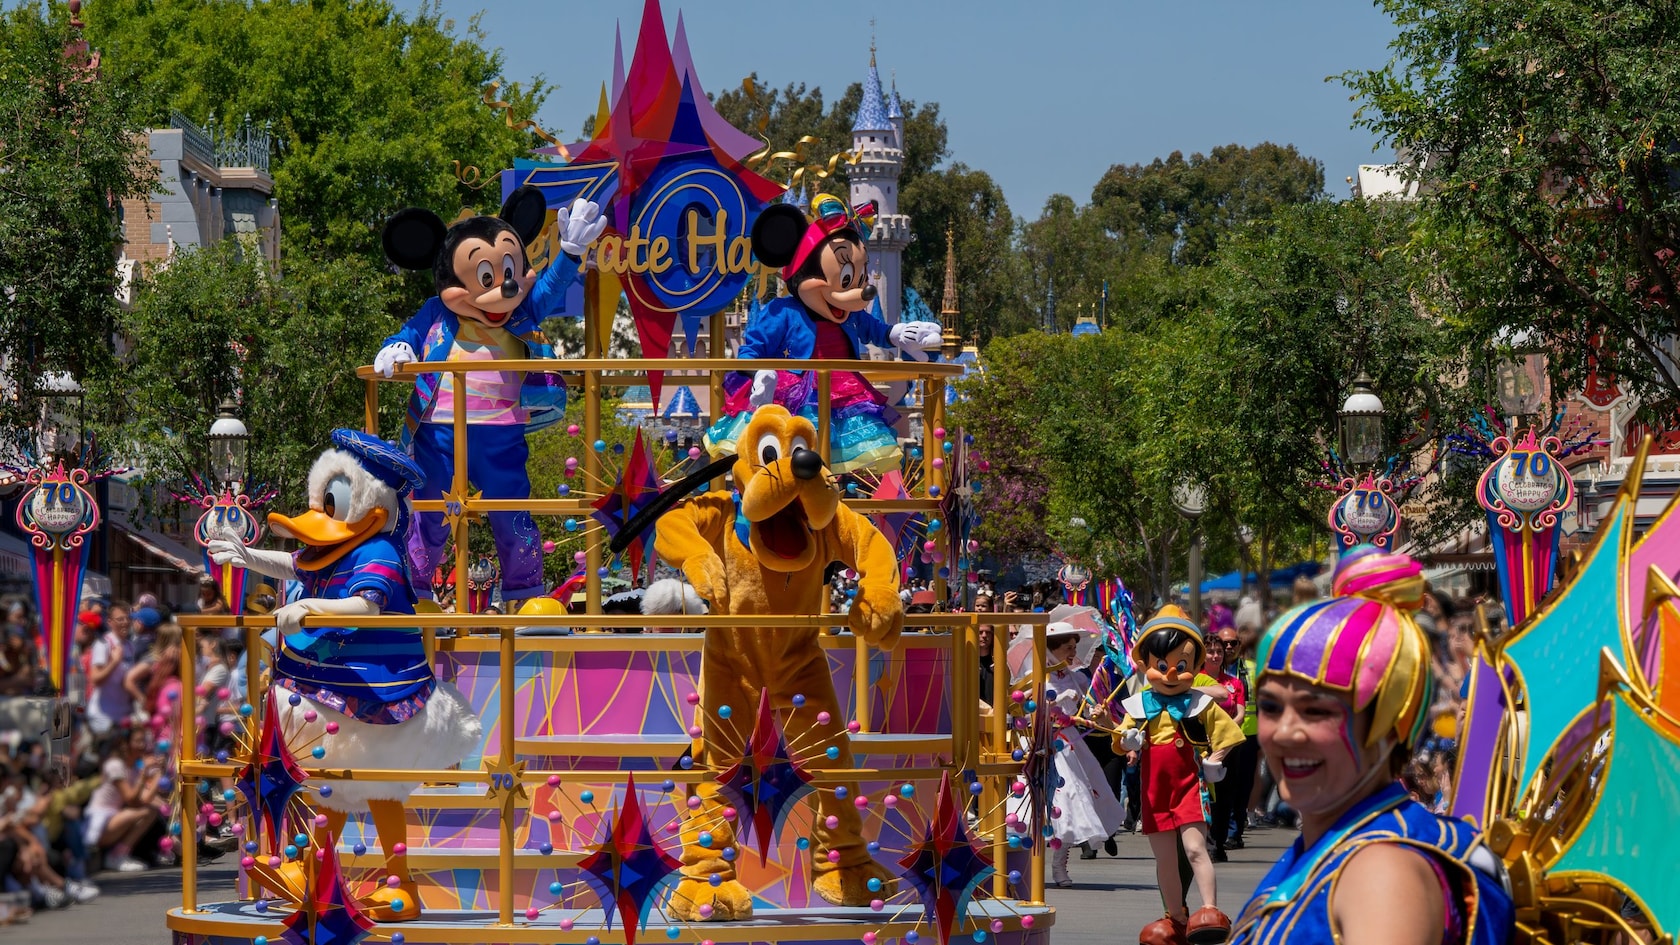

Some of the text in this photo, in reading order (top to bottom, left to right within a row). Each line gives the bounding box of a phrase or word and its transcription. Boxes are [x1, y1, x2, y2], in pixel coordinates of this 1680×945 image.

[1511, 452, 1550, 477] 70
[42, 482, 76, 503] 70
[1354, 490, 1383, 509] 70
[214, 505, 241, 523] 70
[446, 501, 461, 516] 70
[491, 773, 513, 790] 70
